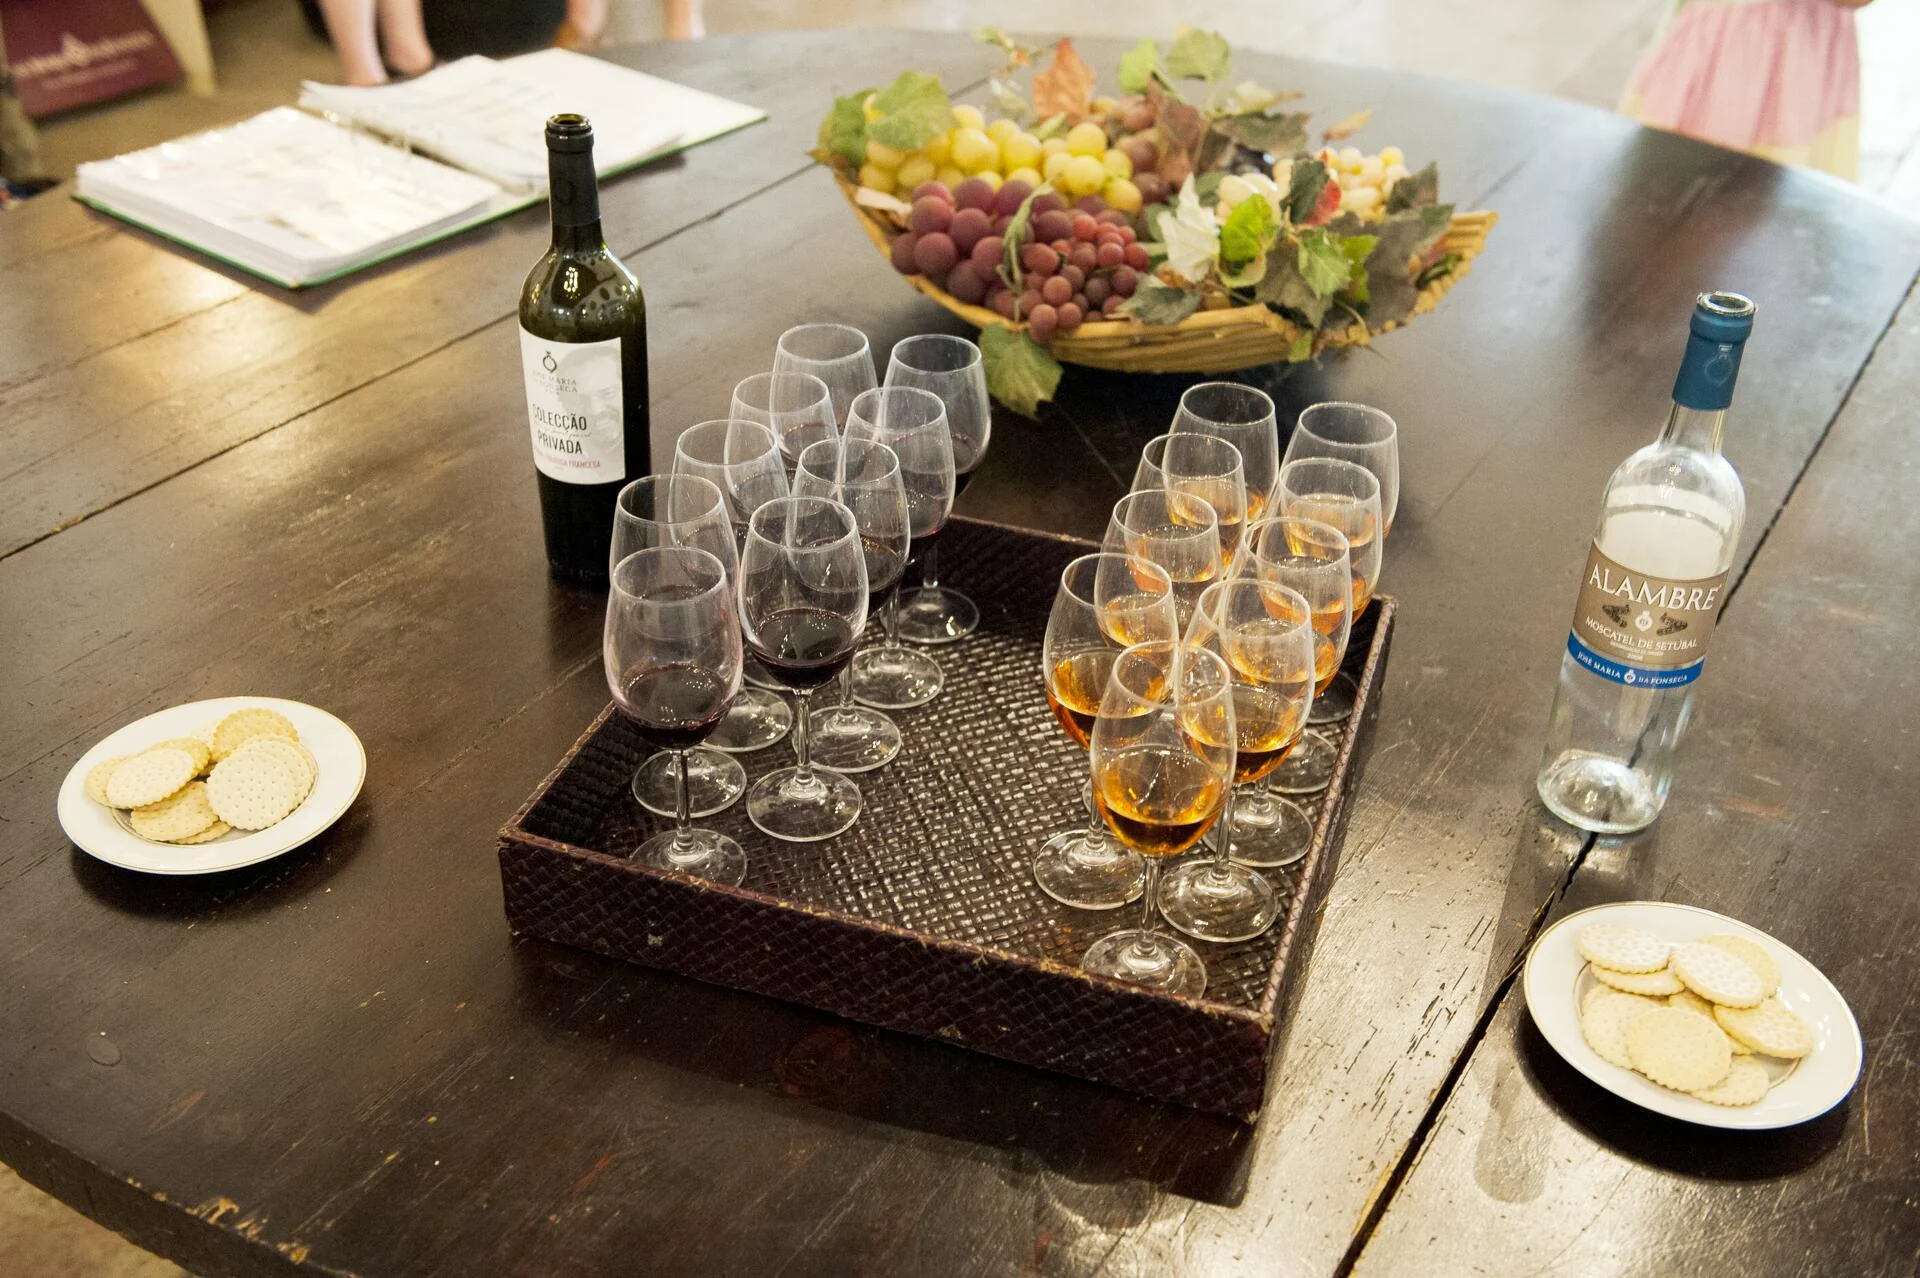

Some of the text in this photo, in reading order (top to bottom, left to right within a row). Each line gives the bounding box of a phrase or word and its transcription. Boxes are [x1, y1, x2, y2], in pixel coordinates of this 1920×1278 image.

[532, 403, 587, 433] COLECÇÃO
[537, 429, 583, 455] PRIVADA
[1588, 562, 1723, 611] ALAMBRE
[1585, 615, 1634, 646] MOSCATEL
[1637, 638, 1653, 650] DE
[1593, 662, 1621, 679] MARIA
[1650, 674, 1688, 685] FONSECA
